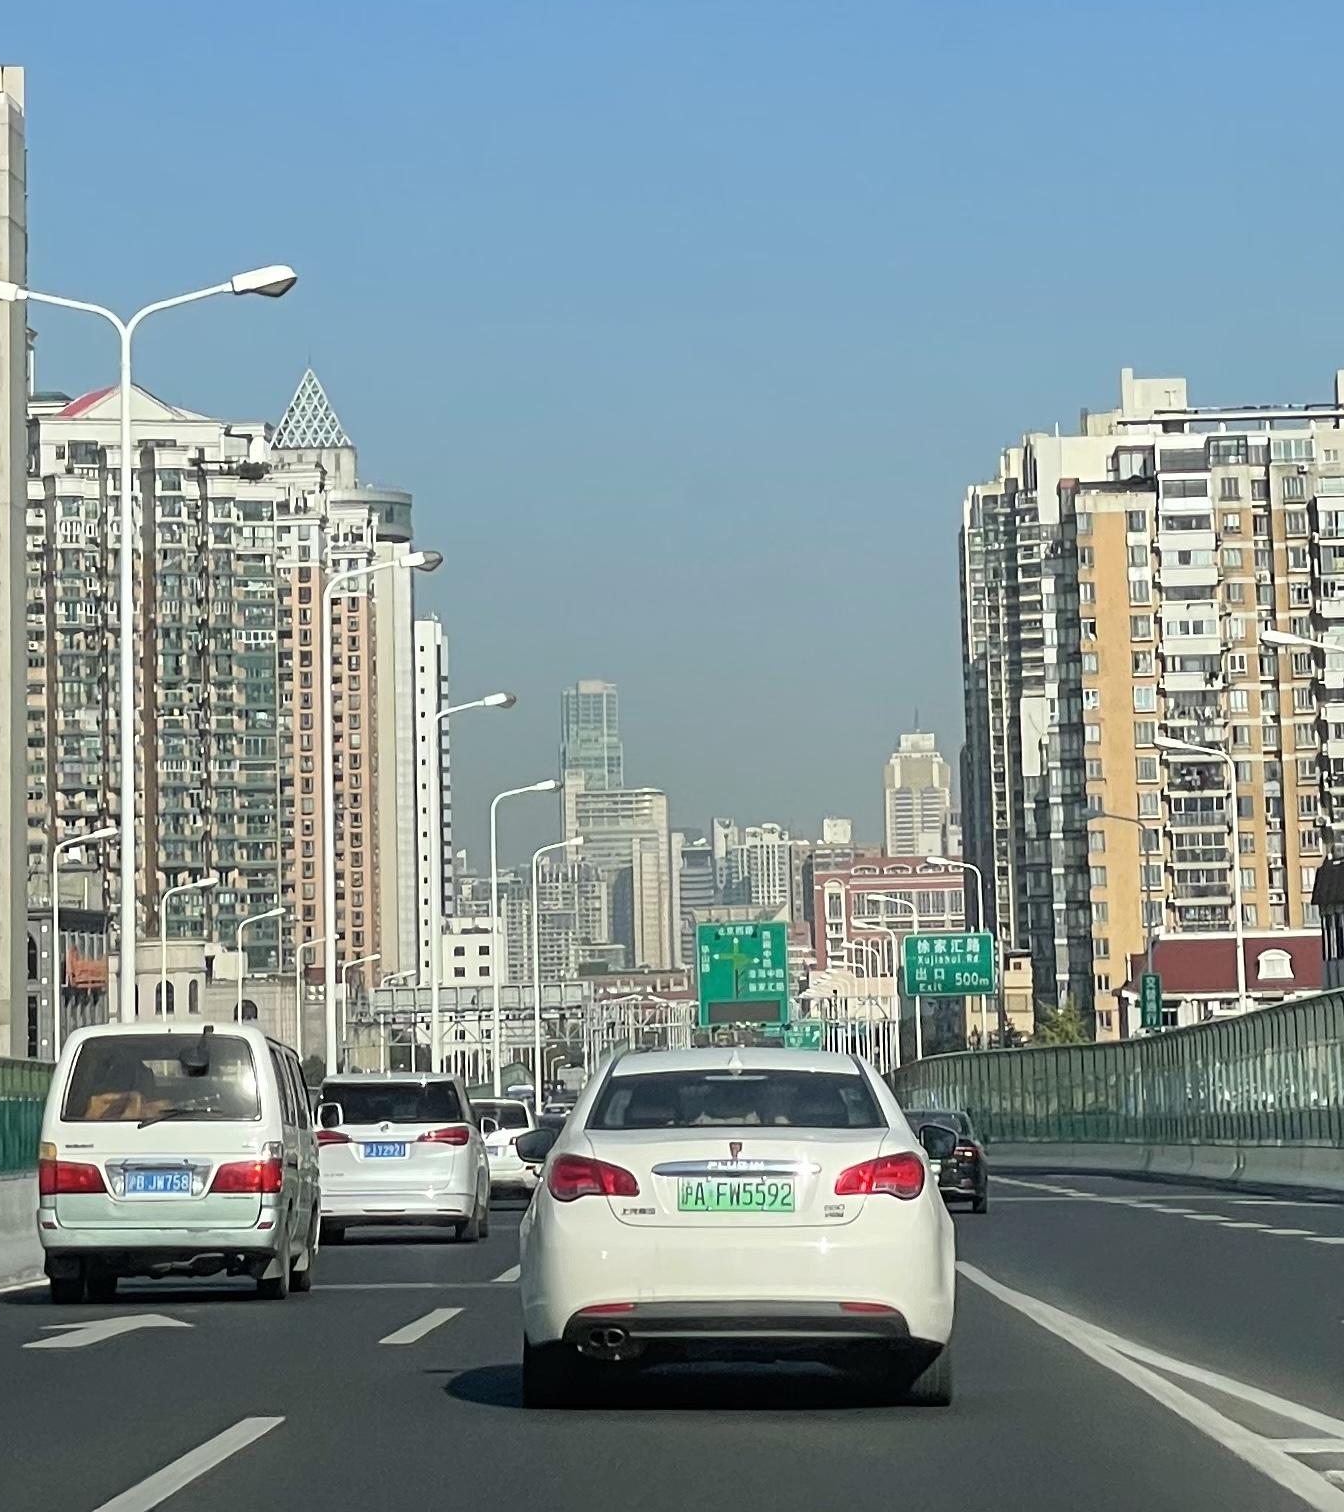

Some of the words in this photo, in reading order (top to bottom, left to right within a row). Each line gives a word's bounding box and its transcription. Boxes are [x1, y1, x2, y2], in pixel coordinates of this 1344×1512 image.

[917, 938, 980, 954] 徐家汇路
[915, 968, 945, 981] 出口
[955, 972, 989, 986] 500m
[919, 983, 942, 991] Exit
